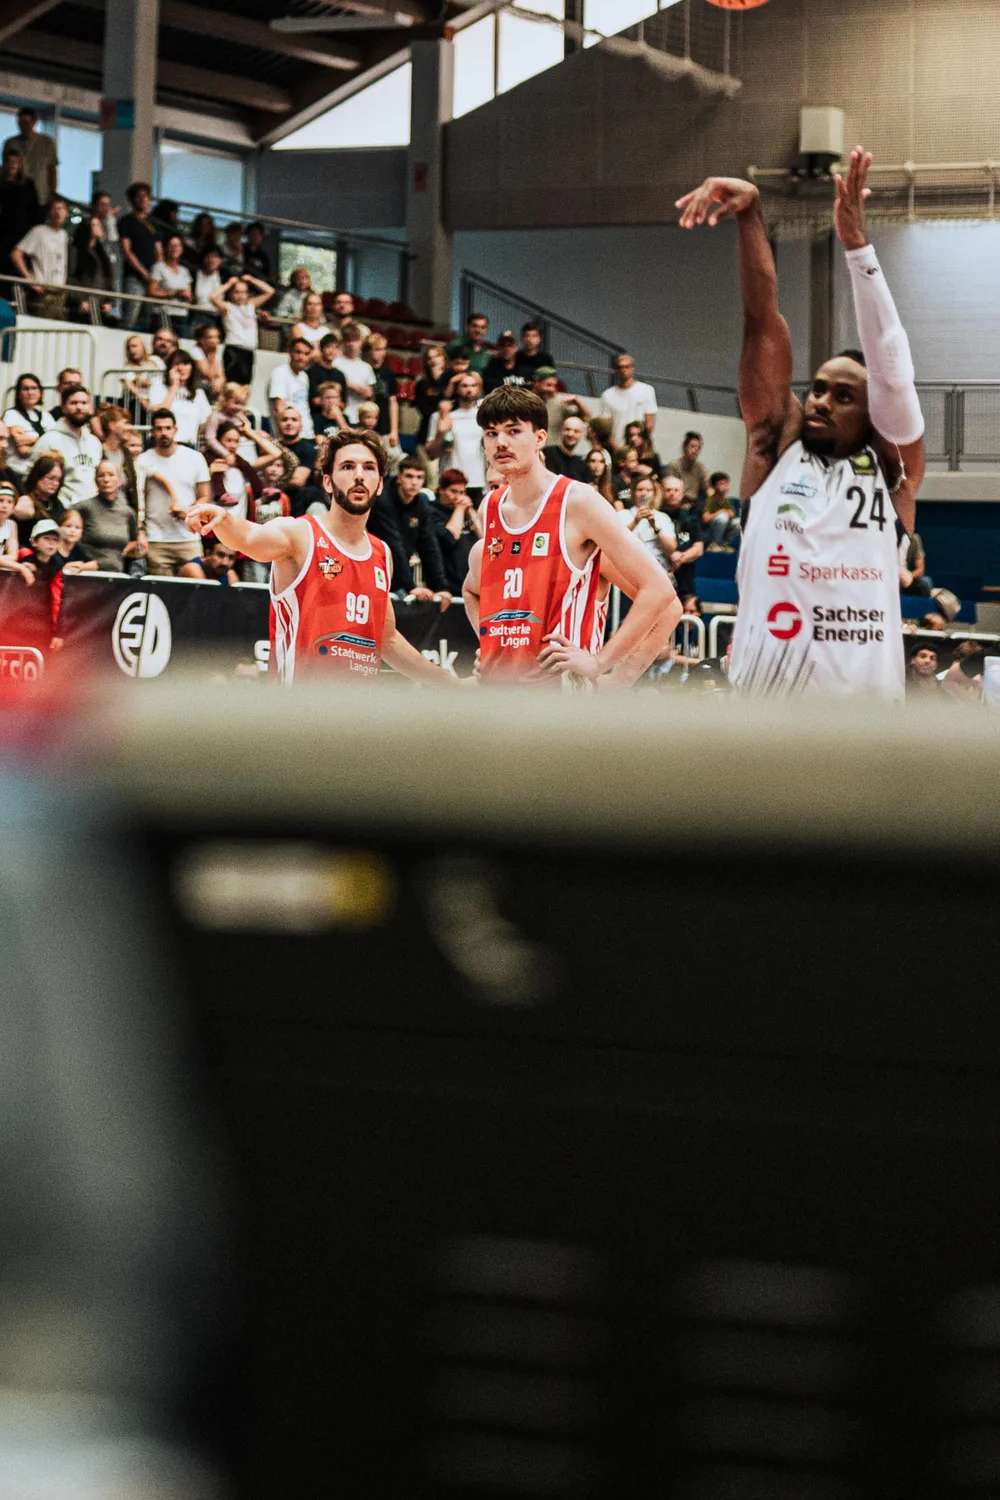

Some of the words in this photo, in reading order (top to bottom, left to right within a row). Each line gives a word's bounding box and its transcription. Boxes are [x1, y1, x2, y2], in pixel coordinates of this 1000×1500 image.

[847, 486, 886, 532] 24
[774, 518, 804, 535] GWG
[503, 568, 523, 599] 20
[345, 591, 370, 625] 99
[812, 626, 884, 645] Energie
